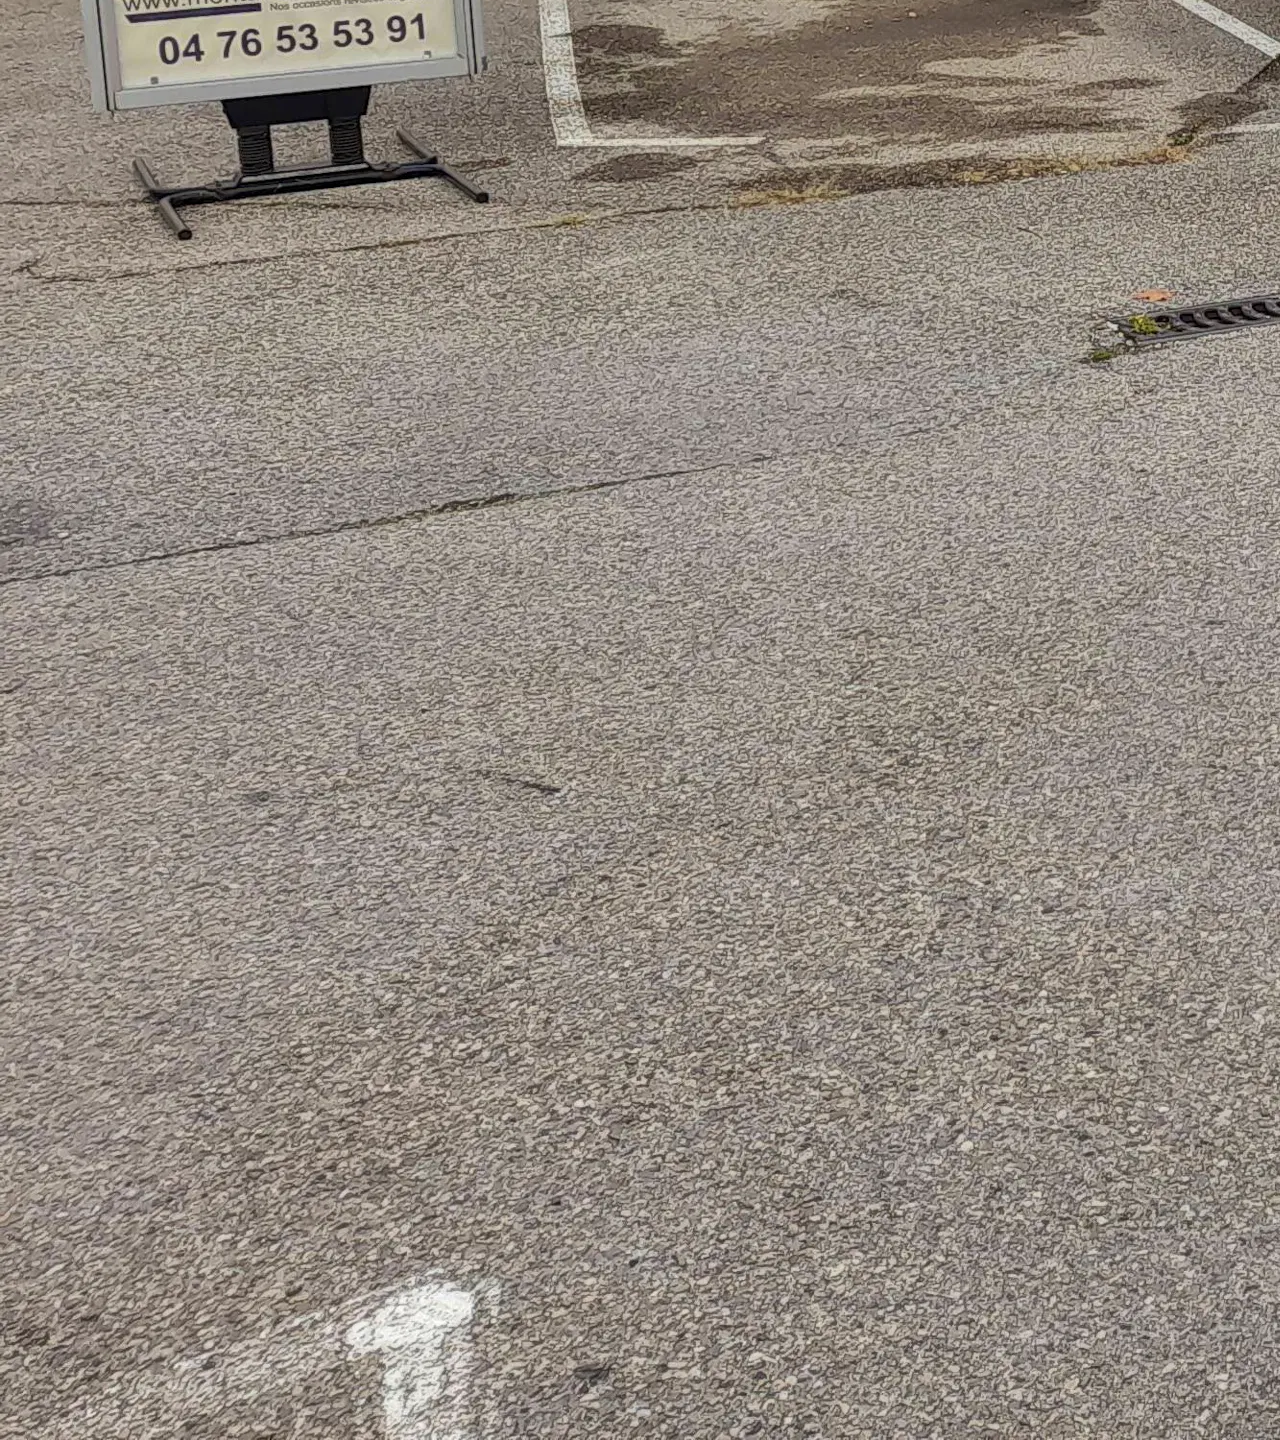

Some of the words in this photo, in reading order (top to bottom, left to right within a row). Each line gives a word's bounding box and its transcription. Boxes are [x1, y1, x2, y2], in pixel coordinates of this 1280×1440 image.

[270, 2, 290, 11] Nos
[159, 33, 205, 65] 04
[217, 28, 262, 58] 76
[276, 23, 319, 53] 53
[333, 18, 375, 48] 53
[387, 13, 426, 43] 91
